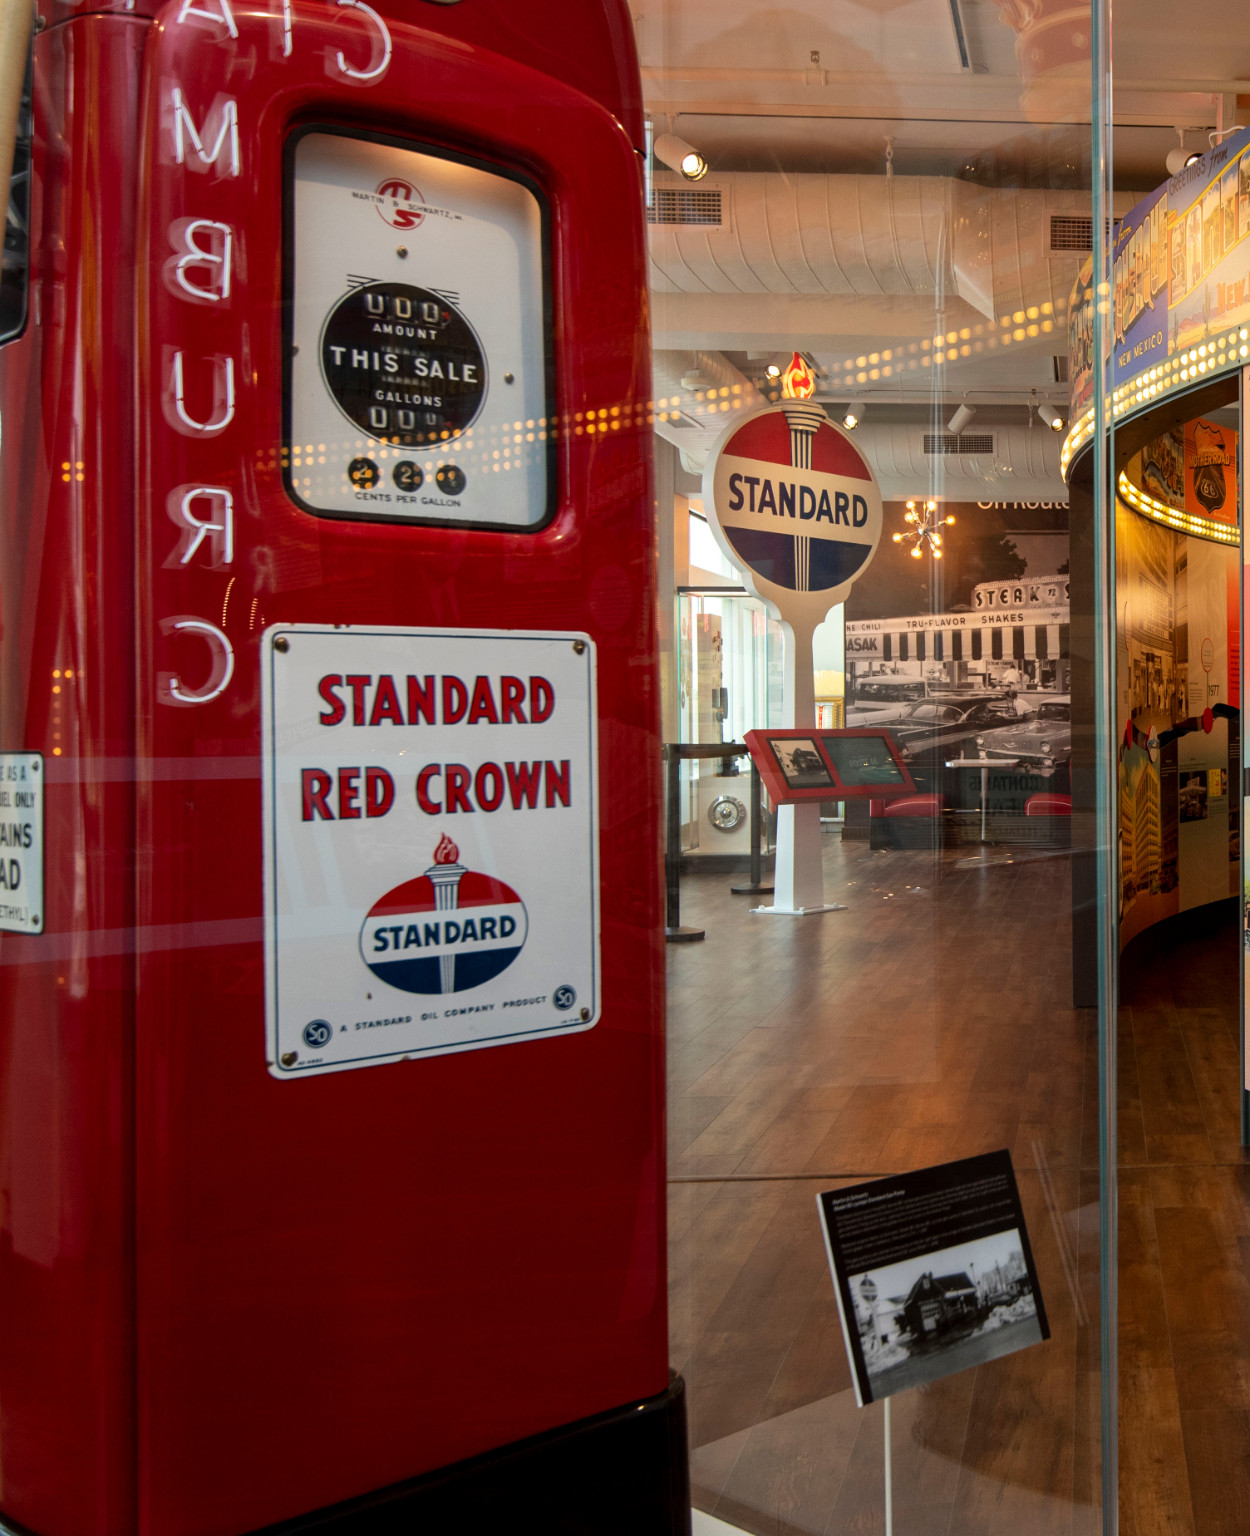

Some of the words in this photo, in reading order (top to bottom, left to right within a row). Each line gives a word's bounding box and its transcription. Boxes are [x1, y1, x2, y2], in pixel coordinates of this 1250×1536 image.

[1207, 147, 1229, 178] from
[351, 191, 385, 205] MARTIN
[1217, 278, 1245, 315] NEW
[372, 323, 437, 340] AMOUNT
[330, 346, 399, 373] THIS
[414, 358, 478, 384] SALE
[1118, 352, 1132, 369] NEW
[1133, 331, 1164, 358] MEXICO
[374, 389, 442, 407] GALLONS
[355, 491, 392, 502] CENTS
[396, 495, 418, 504] PER
[419, 497, 461, 508] GALLON
[728, 472, 868, 528] STANDARD
[974, 585, 1040, 607] STEAK
[862, 622, 881, 631] CHILI
[906, 617, 966, 629] TRU-FLAVOR
[981, 613, 1024, 624] SHAKES
[317, 674, 556, 728] STANDARD
[15, 791, 36, 808] ONLY
[300, 764, 395, 823] RED
[416, 759, 572, 816] CROWN
[0, 822, 33, 849] AINS
[373, 915, 517, 952] STANDARD
[354, 1015, 413, 1031] STANDARD
[421, 1012, 439, 1021] OIL
[444, 1003, 495, 1018] COMPANY
[502, 996, 547, 1009] PRODUCT
